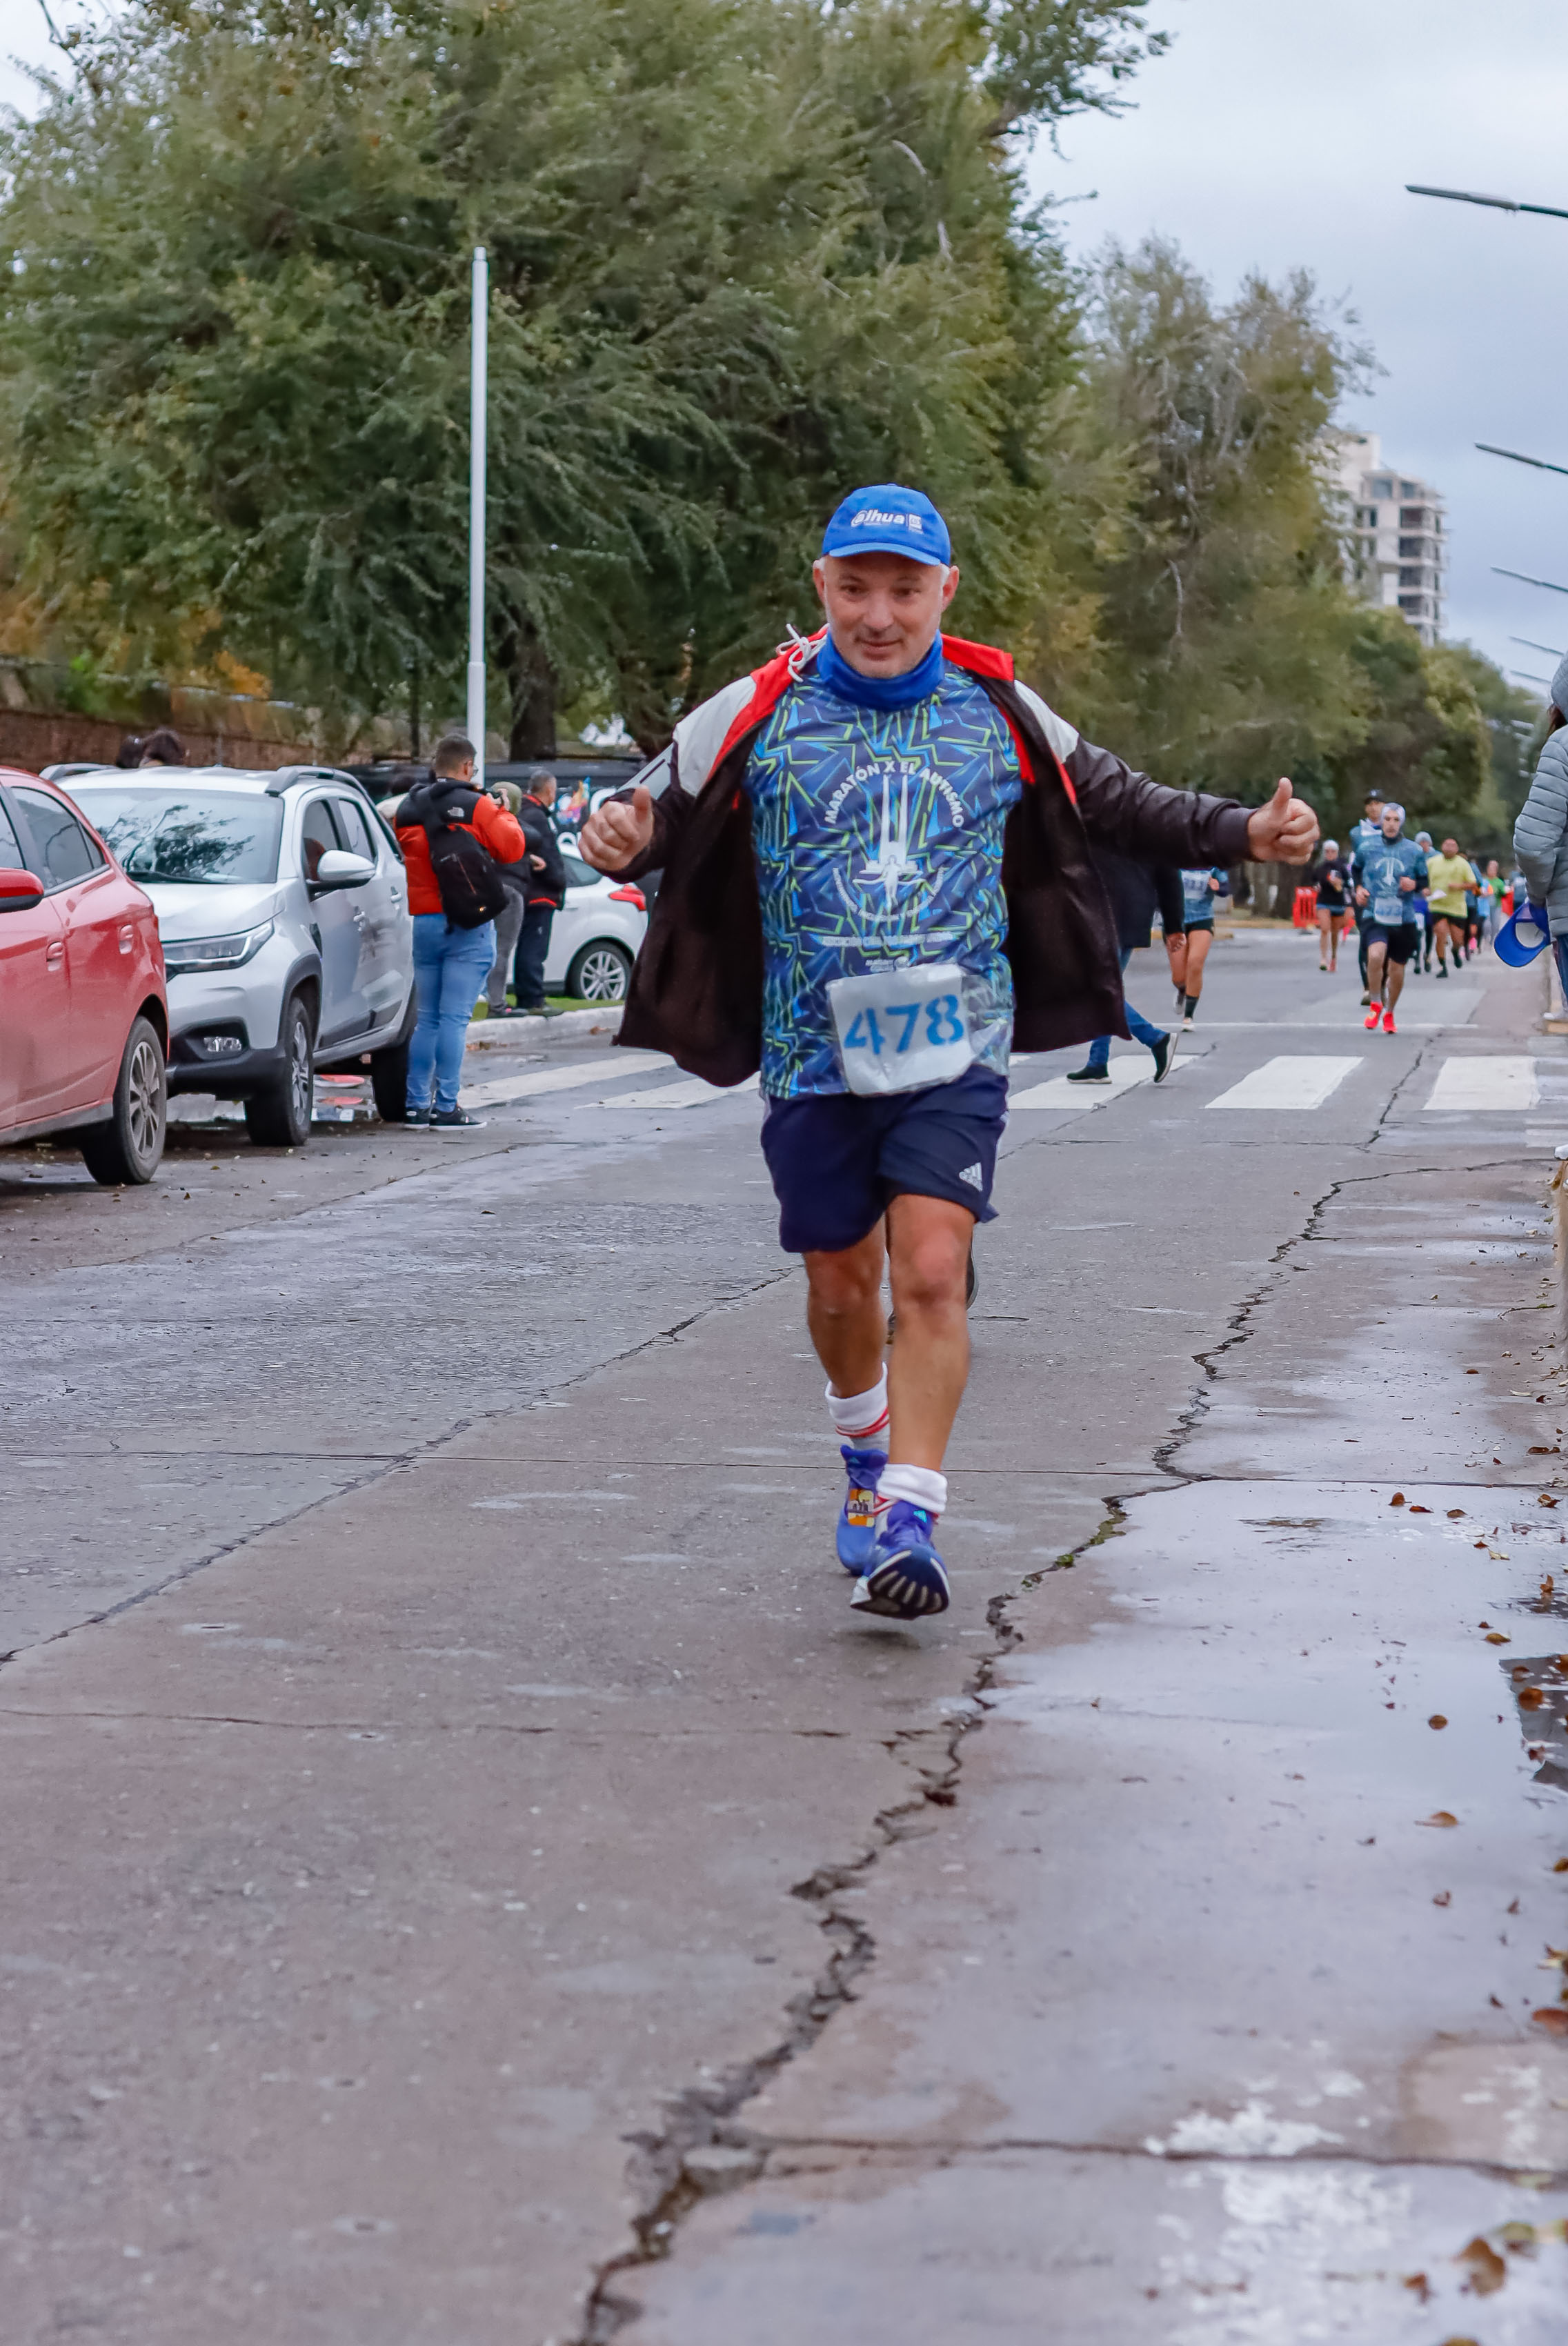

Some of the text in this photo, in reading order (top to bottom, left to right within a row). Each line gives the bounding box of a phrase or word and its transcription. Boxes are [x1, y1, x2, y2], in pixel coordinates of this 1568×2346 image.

[824, 760, 964, 828] MARATÓN X EL AUTISMO
[843, 994, 964, 1056] 478
